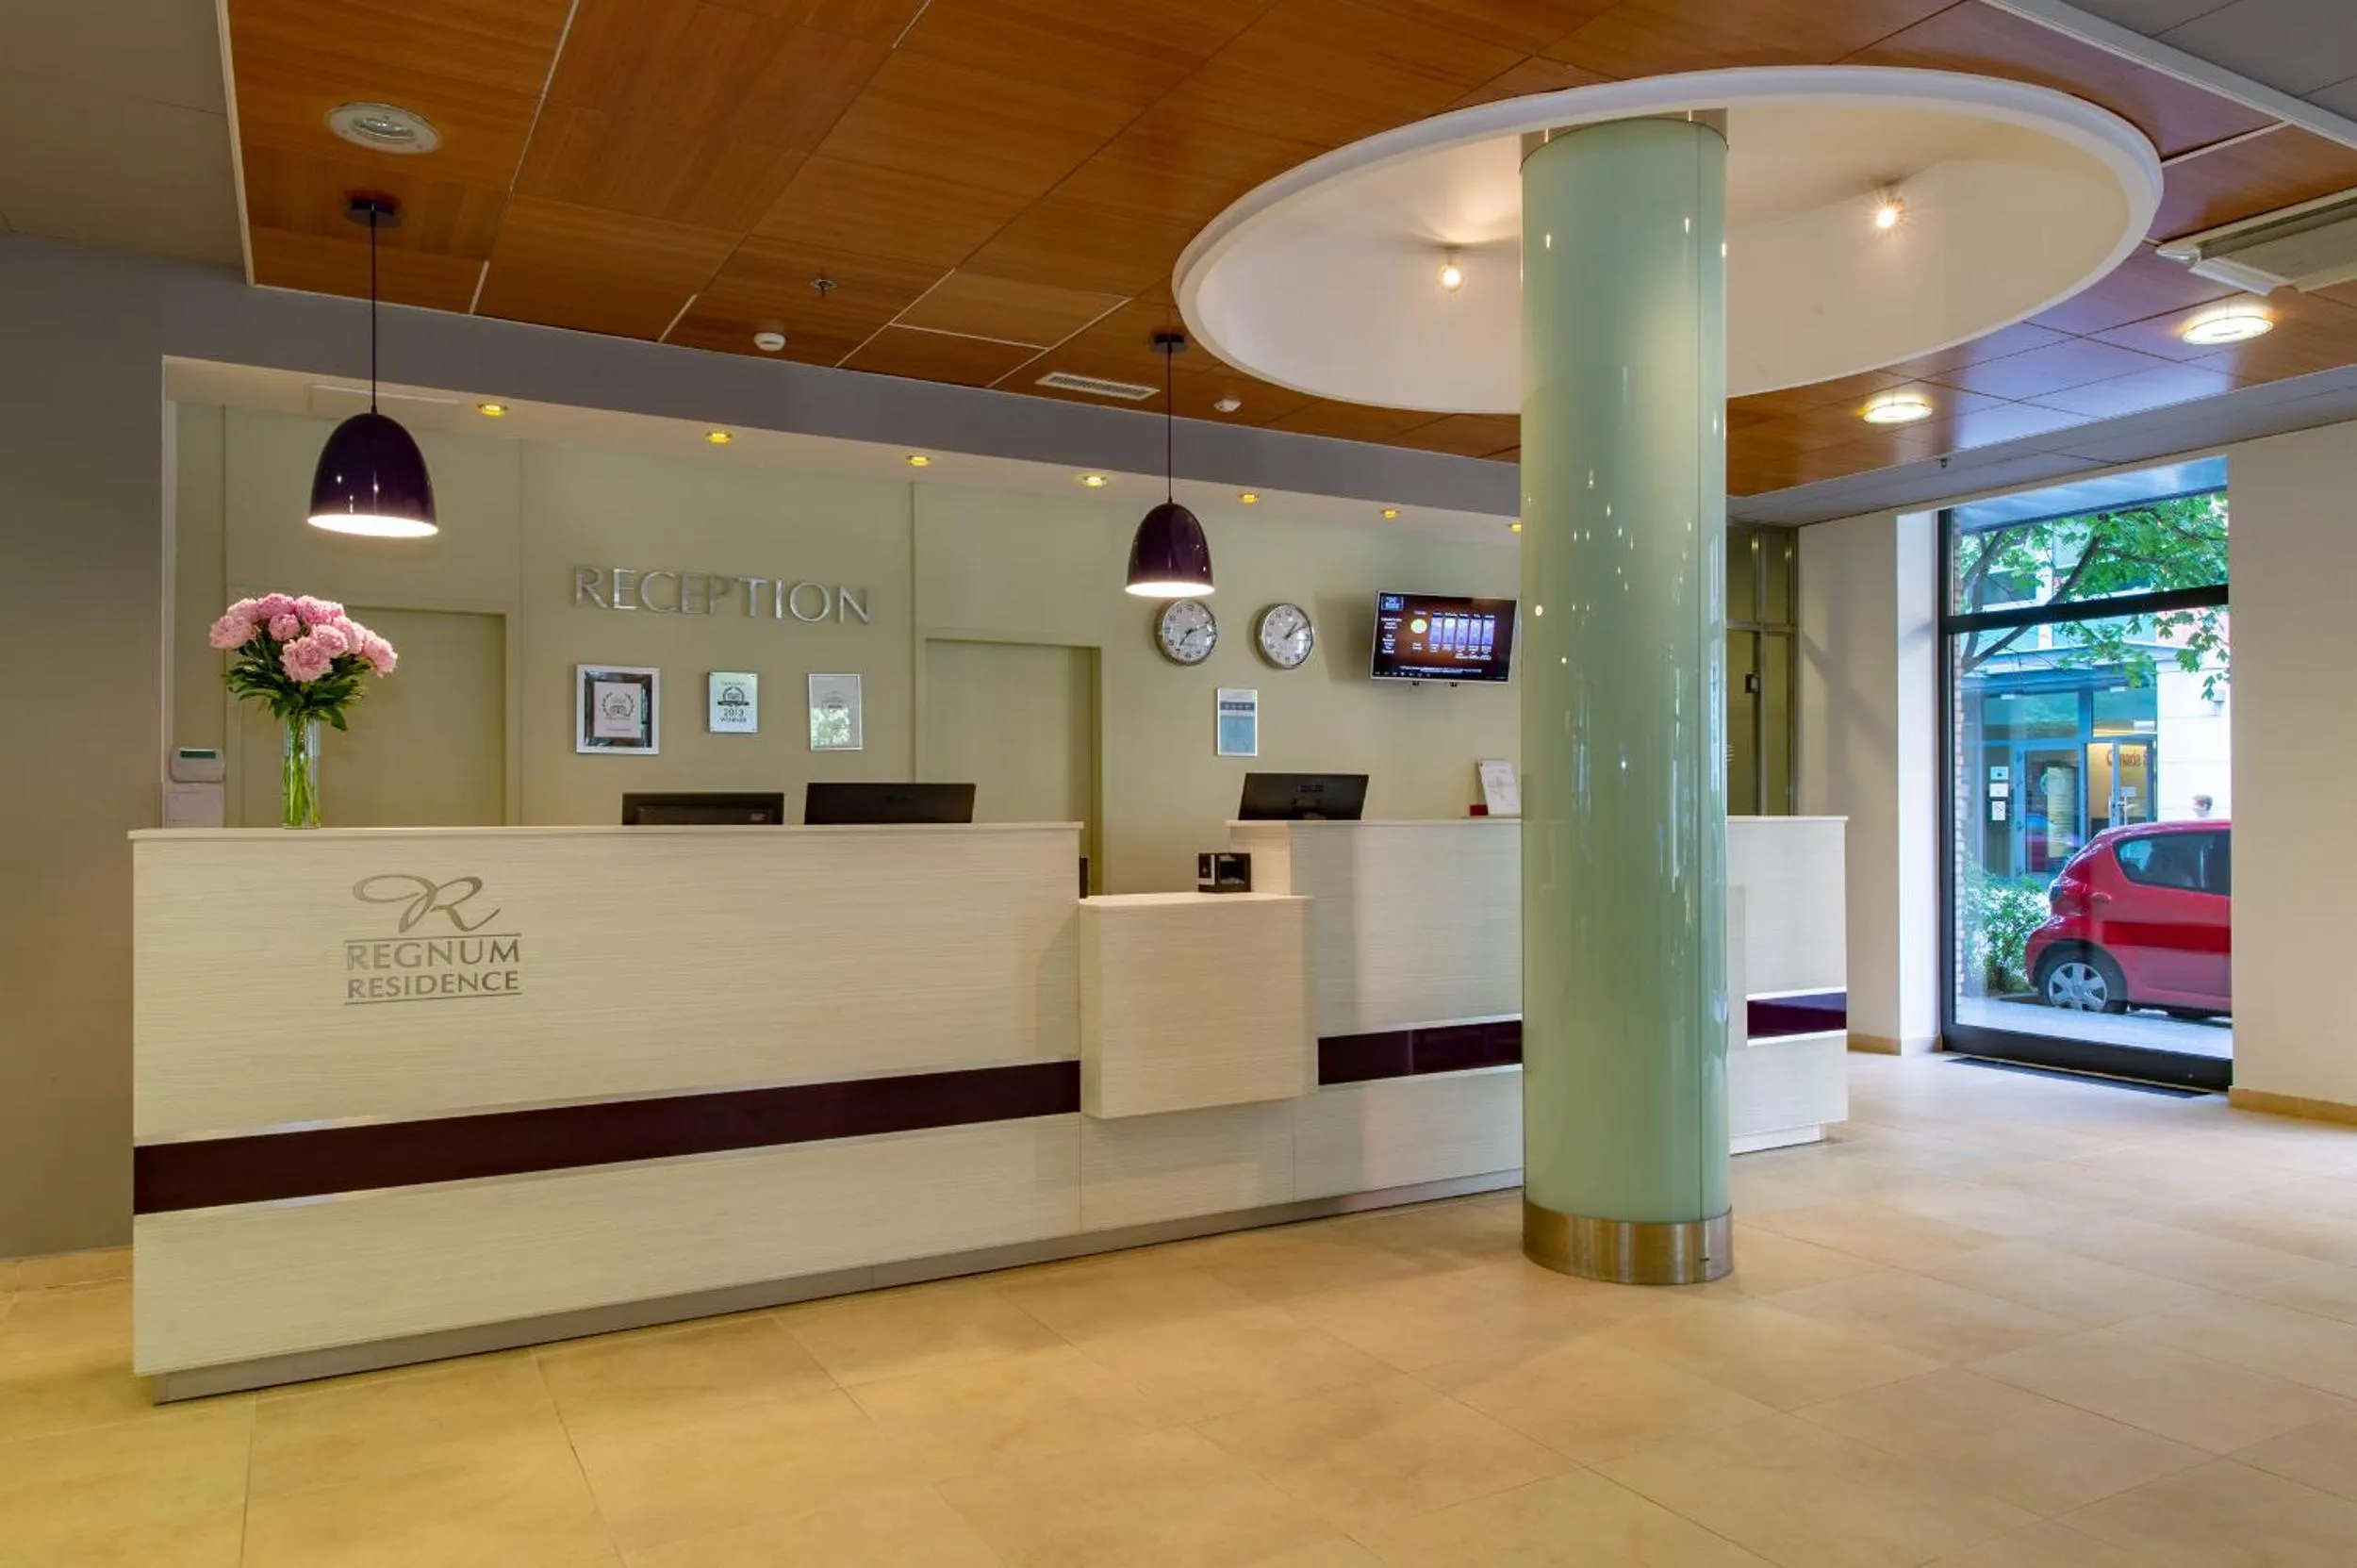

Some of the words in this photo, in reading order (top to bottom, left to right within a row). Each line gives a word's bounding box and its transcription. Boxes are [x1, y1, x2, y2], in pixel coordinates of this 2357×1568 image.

[573, 566, 870, 624] RECEPTION
[346, 938, 520, 971] REGNUM
[347, 970, 519, 999] RESIDENCE
